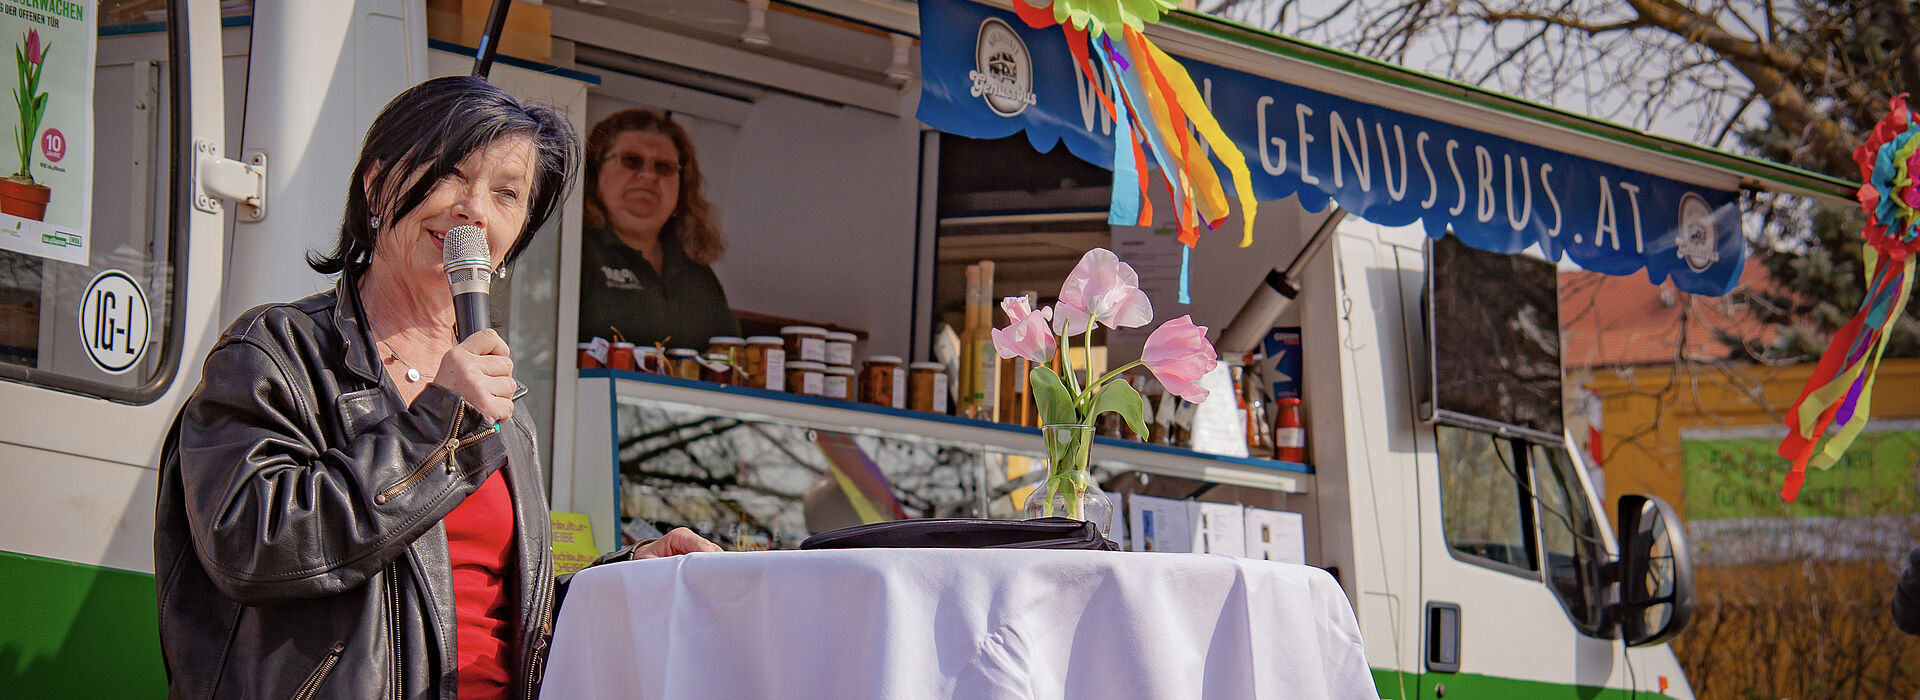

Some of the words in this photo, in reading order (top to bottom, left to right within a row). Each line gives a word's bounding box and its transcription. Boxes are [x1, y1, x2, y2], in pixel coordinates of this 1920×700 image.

[5, 4, 17, 16] DER
[18, 8, 45, 24] OFFENEN
[969, 69, 1037, 105] Genussbus
[46, 134, 61, 152] 10
[1256, 95, 1644, 254] GENUSSBUS.AT
[94, 290, 135, 354] IG-L
